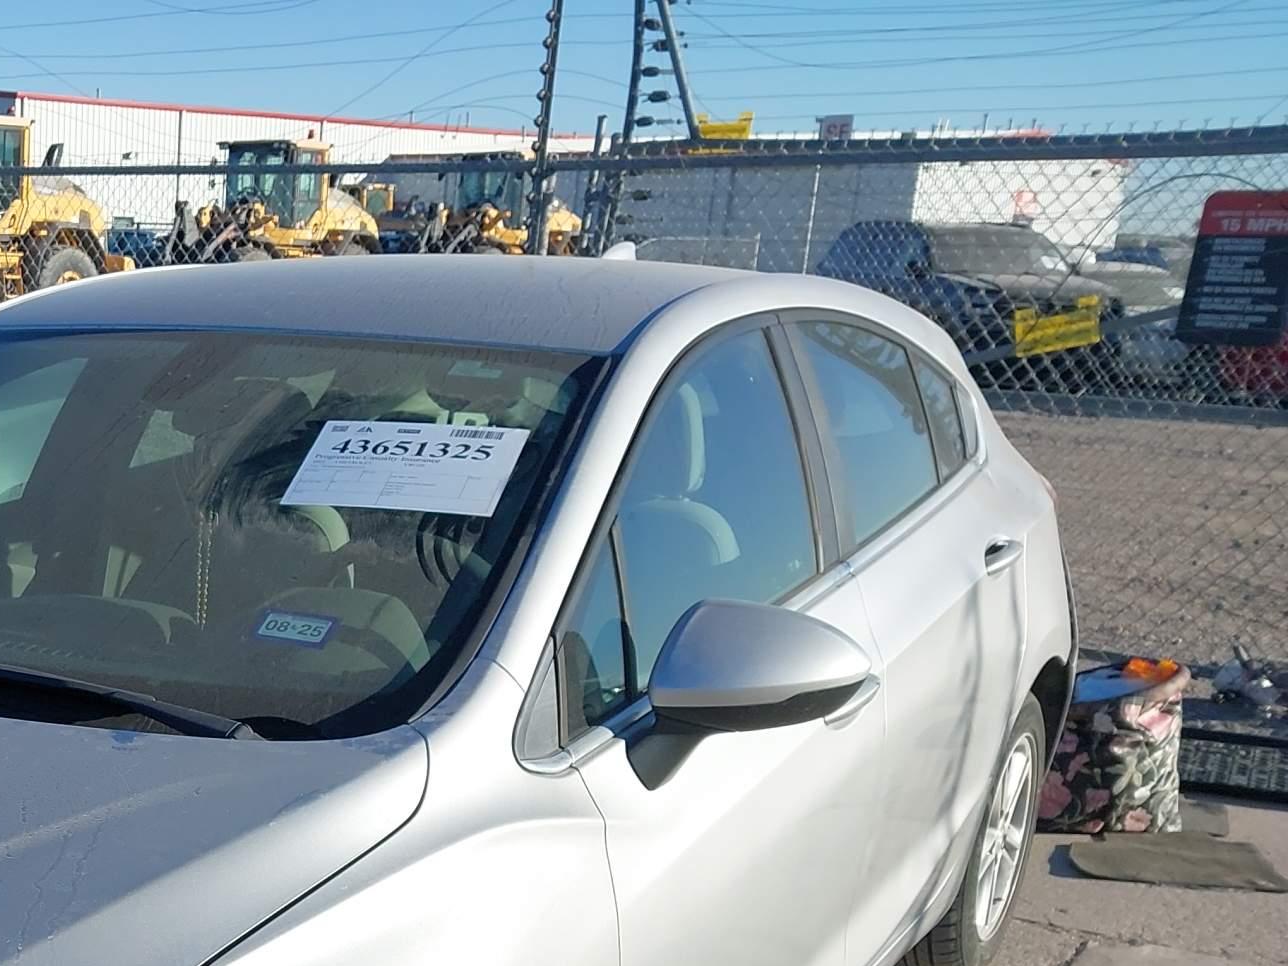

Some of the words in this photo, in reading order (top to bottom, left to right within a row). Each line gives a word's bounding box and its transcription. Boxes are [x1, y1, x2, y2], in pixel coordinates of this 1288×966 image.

[1221, 218, 1241, 232] 15
[331, 438, 495, 461] 43651325
[265, 619, 290, 632] 08
[296, 623, 325, 637] 25
